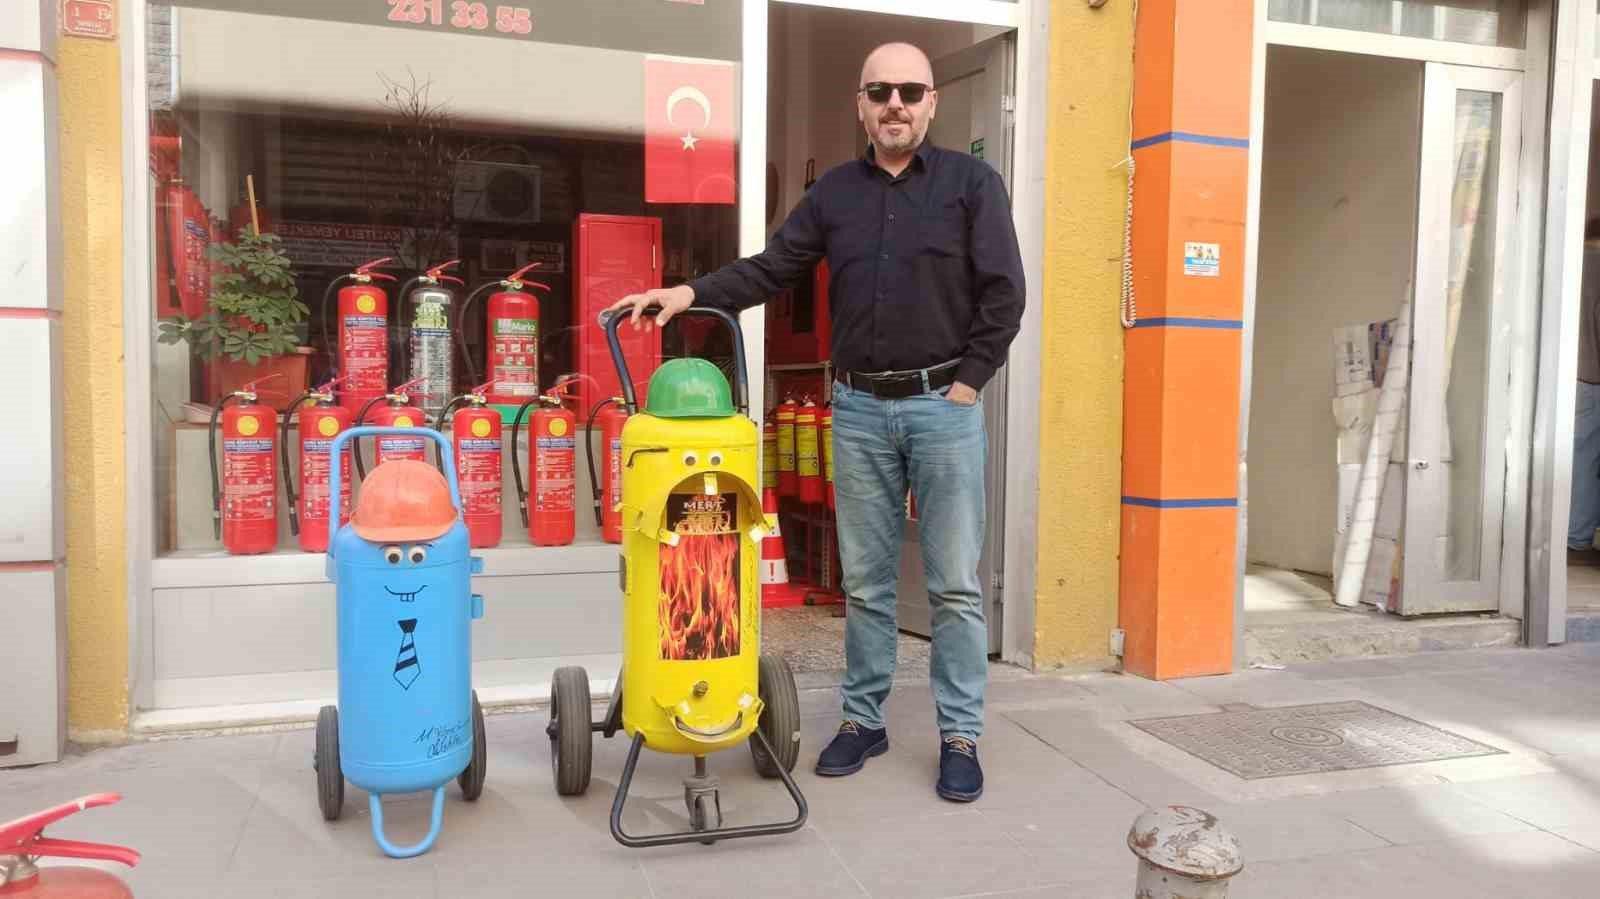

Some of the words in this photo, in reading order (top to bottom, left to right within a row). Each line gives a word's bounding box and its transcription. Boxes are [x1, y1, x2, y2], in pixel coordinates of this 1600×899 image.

[387, 0, 442, 25] 231
[451, 0, 488, 30] 33
[496, 6, 532, 34] 55
[683, 500, 722, 512] MERT
